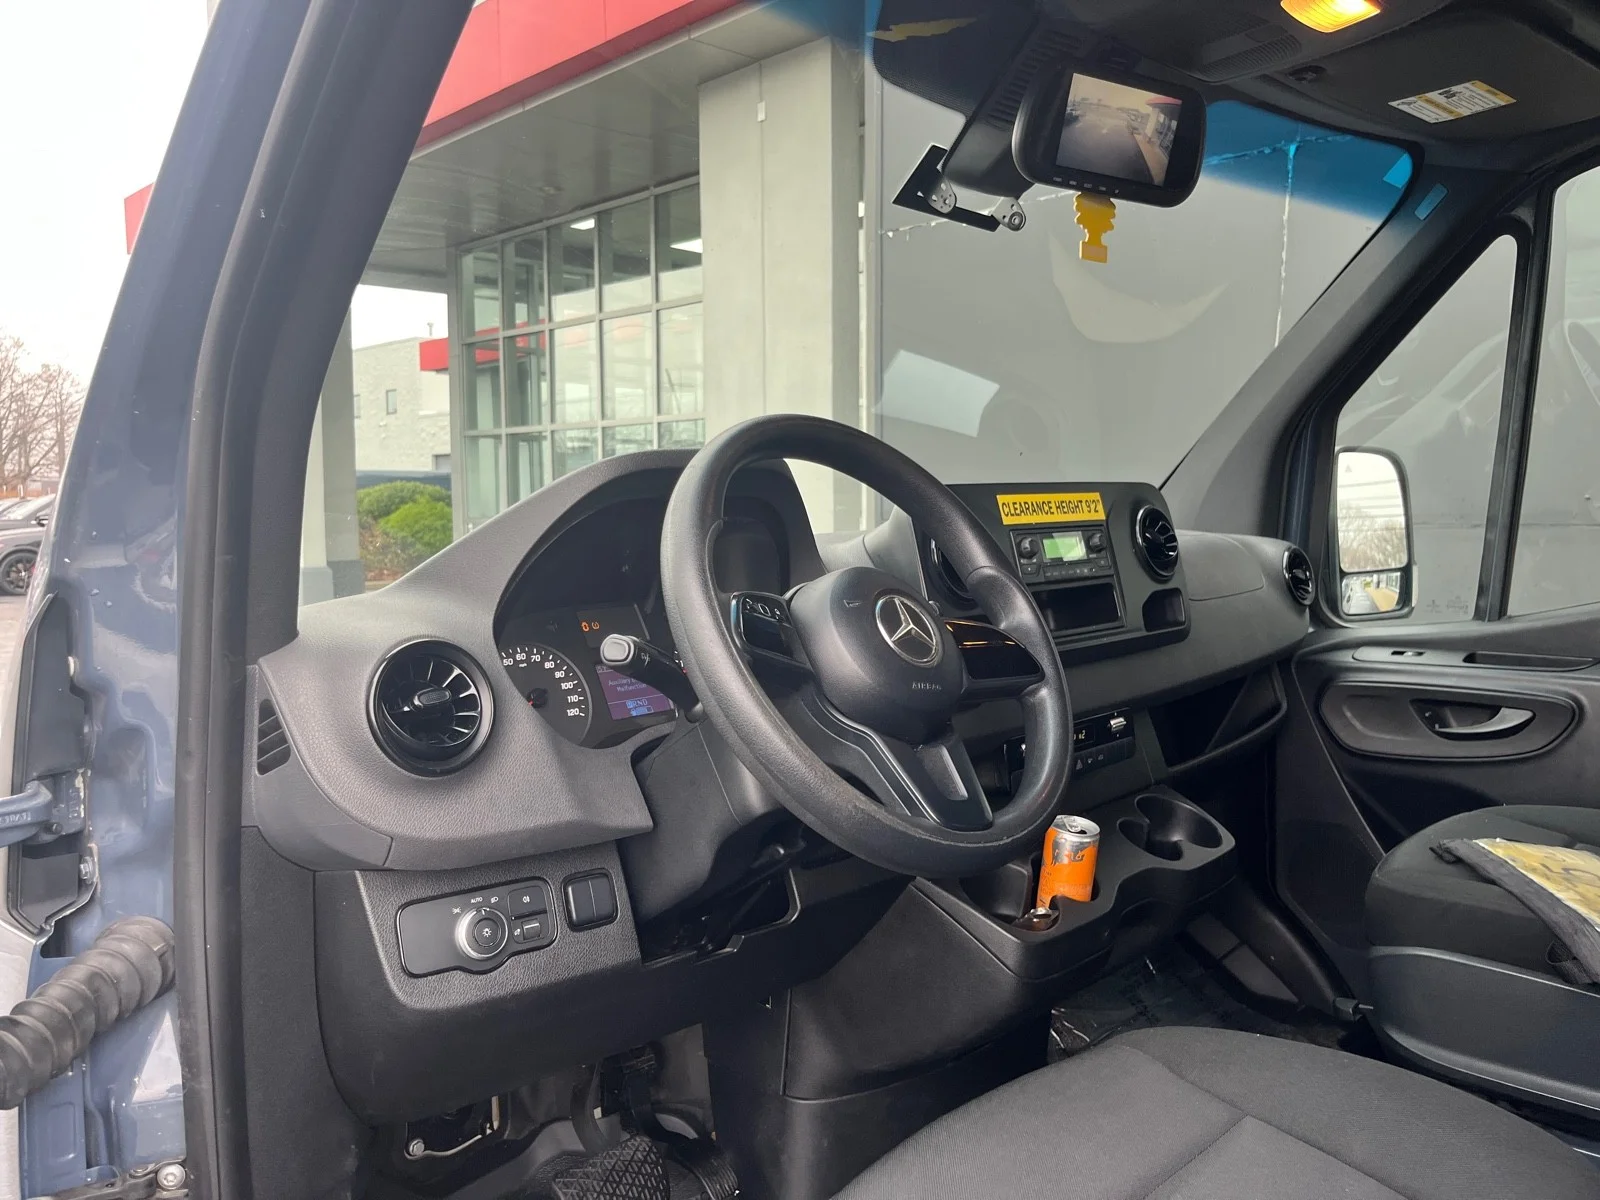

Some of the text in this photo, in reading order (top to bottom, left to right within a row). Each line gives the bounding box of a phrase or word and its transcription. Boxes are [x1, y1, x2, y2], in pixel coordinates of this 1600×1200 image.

[1002, 501, 1054, 517] CLEARANCE
[1054, 500, 1085, 515] HEIGHT
[503, 658, 513, 666] 50
[544, 661, 554, 669] 80
[555, 670, 565, 678] 90
[561, 682, 573, 690] 100
[567, 695, 578, 703] 110
[567, 708, 579, 716] 120
